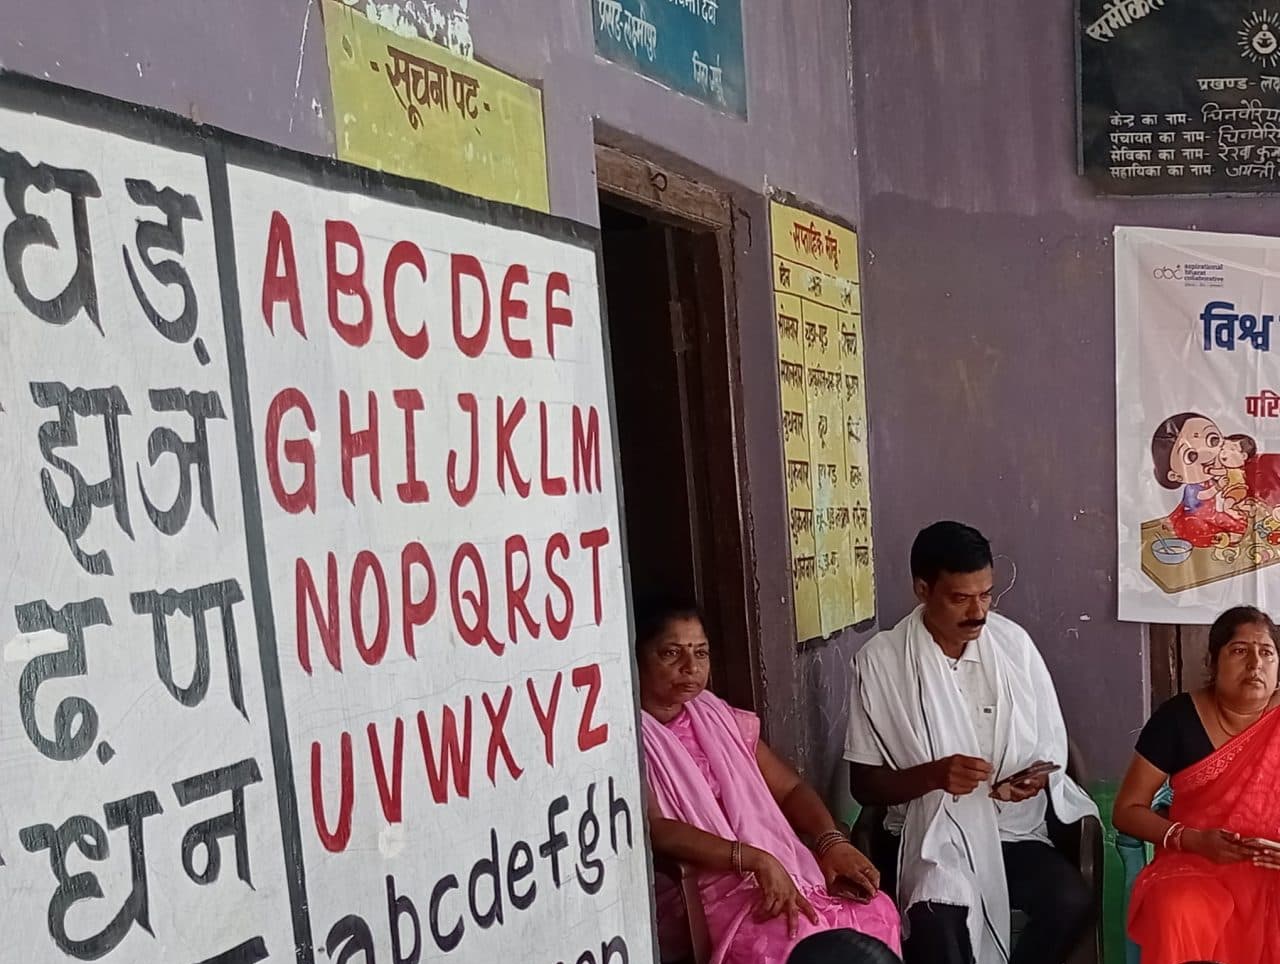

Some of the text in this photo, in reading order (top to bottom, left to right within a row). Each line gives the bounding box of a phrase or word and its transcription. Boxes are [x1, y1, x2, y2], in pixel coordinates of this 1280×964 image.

[387, 45, 481, 129] सूचना पट
[1109, 111, 1135, 128] केन्द्र
[1140, 114, 1158, 125] का
[1109, 130, 1153, 144] पंचायत
[1158, 131, 1176, 143] का
[1109, 145, 1153, 162] सेविका
[1158, 149, 1176, 160] का
[1109, 163, 1162, 179] सहायिका
[1166, 165, 1184, 177] का
[1200, 301, 1273, 352] विश्व
[172, 757, 263, 890] न
